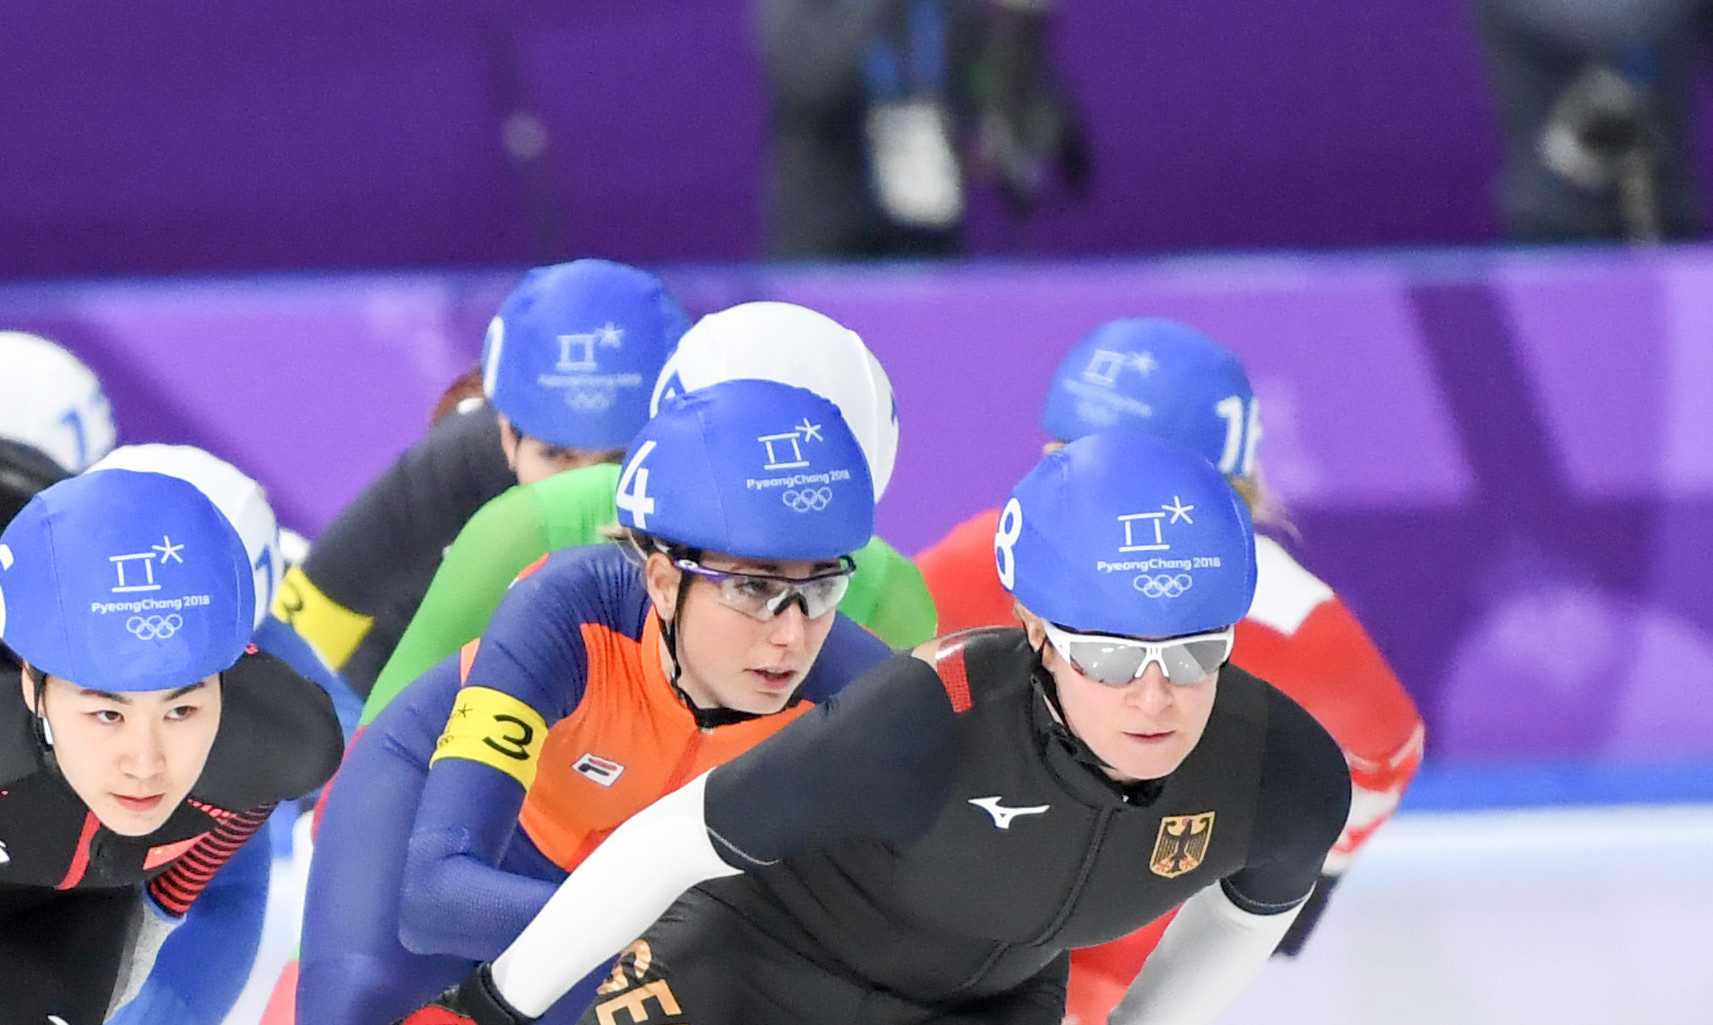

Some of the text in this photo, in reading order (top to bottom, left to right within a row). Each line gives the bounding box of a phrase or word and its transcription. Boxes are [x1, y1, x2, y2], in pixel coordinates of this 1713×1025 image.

[616, 440, 657, 529] 4
[994, 497, 1023, 591] 8
[1096, 556, 1221, 573] PyeongChang 2018
[91, 595, 210, 614] PyeongChang 2018
[482, 713, 534, 761] 3
